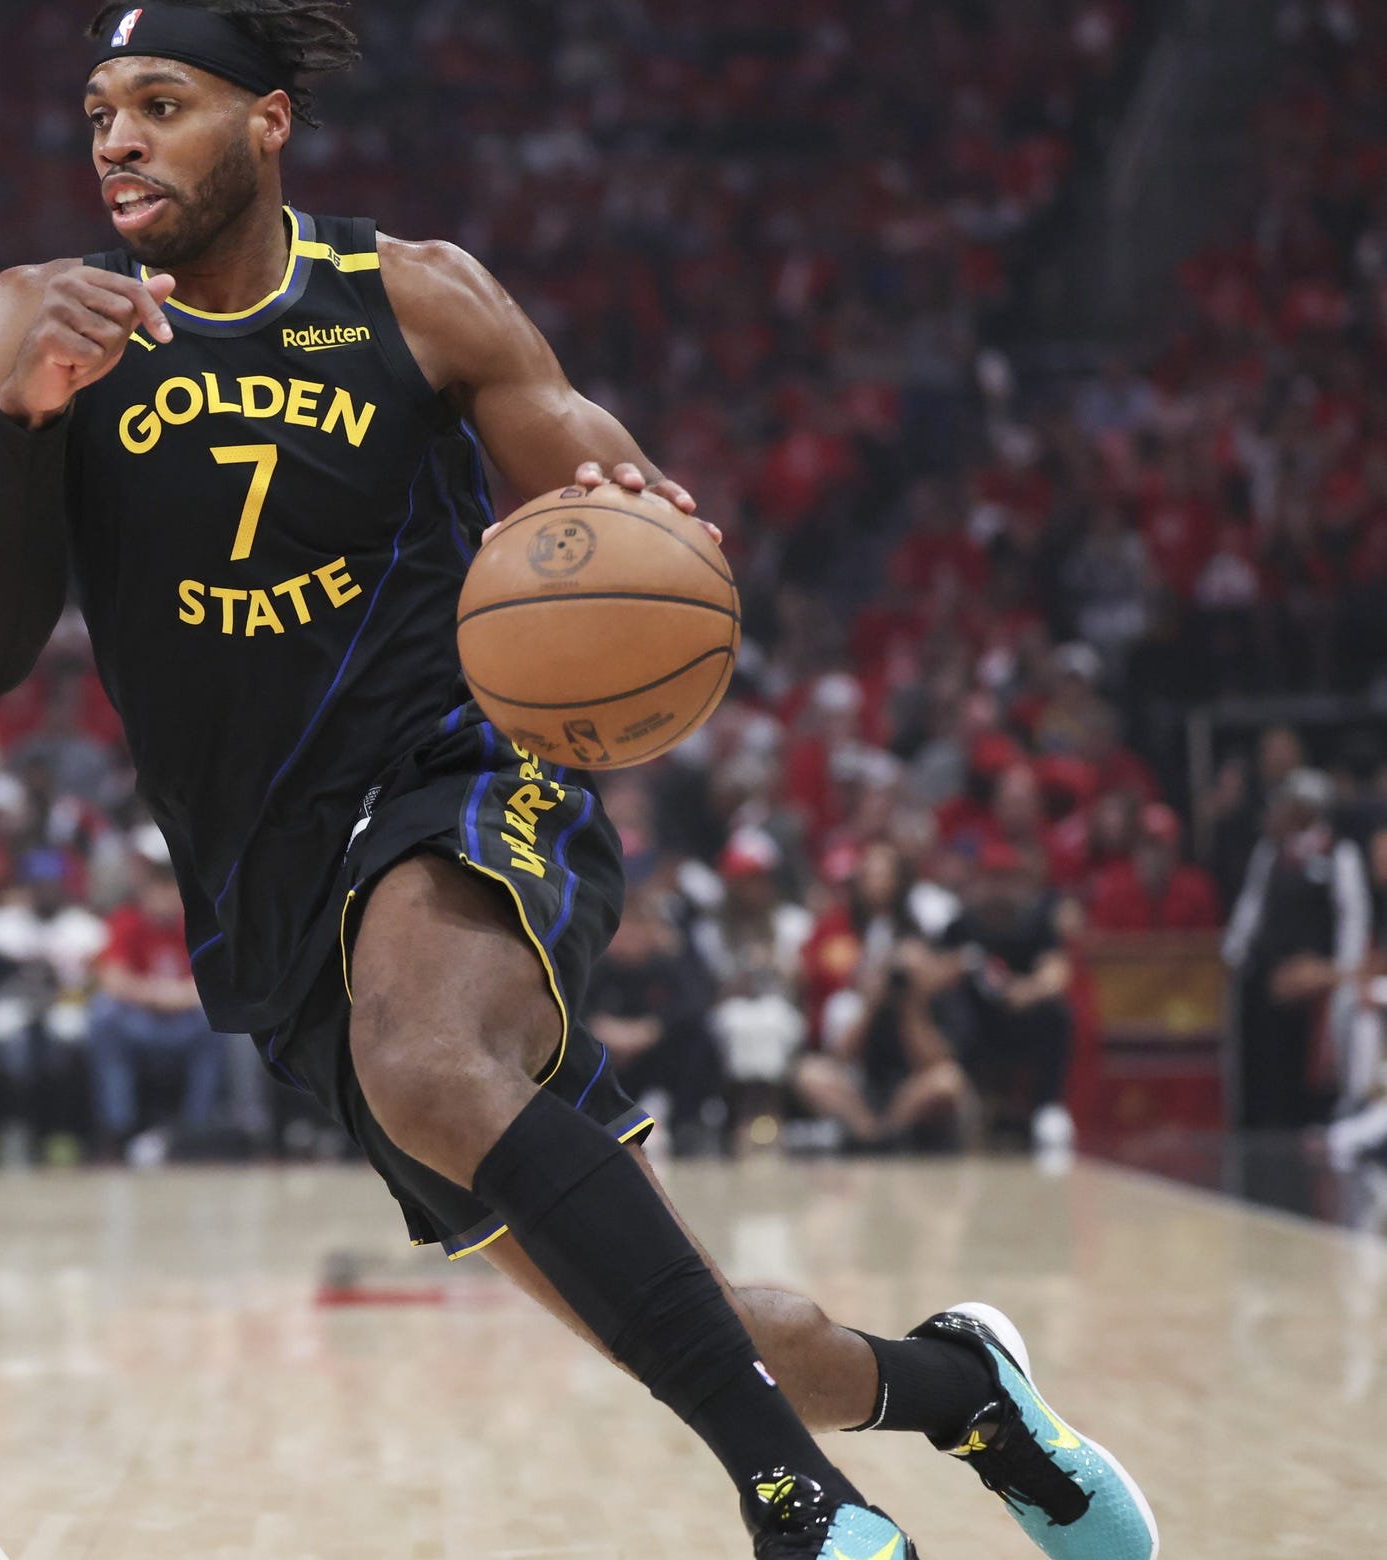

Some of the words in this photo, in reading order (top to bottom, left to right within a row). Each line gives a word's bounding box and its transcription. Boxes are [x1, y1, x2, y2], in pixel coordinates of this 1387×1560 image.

[282, 324, 371, 348] Rakuten
[118, 371, 377, 455] GOLDEN
[209, 443, 279, 562] 7
[178, 556, 363, 637] STATE
